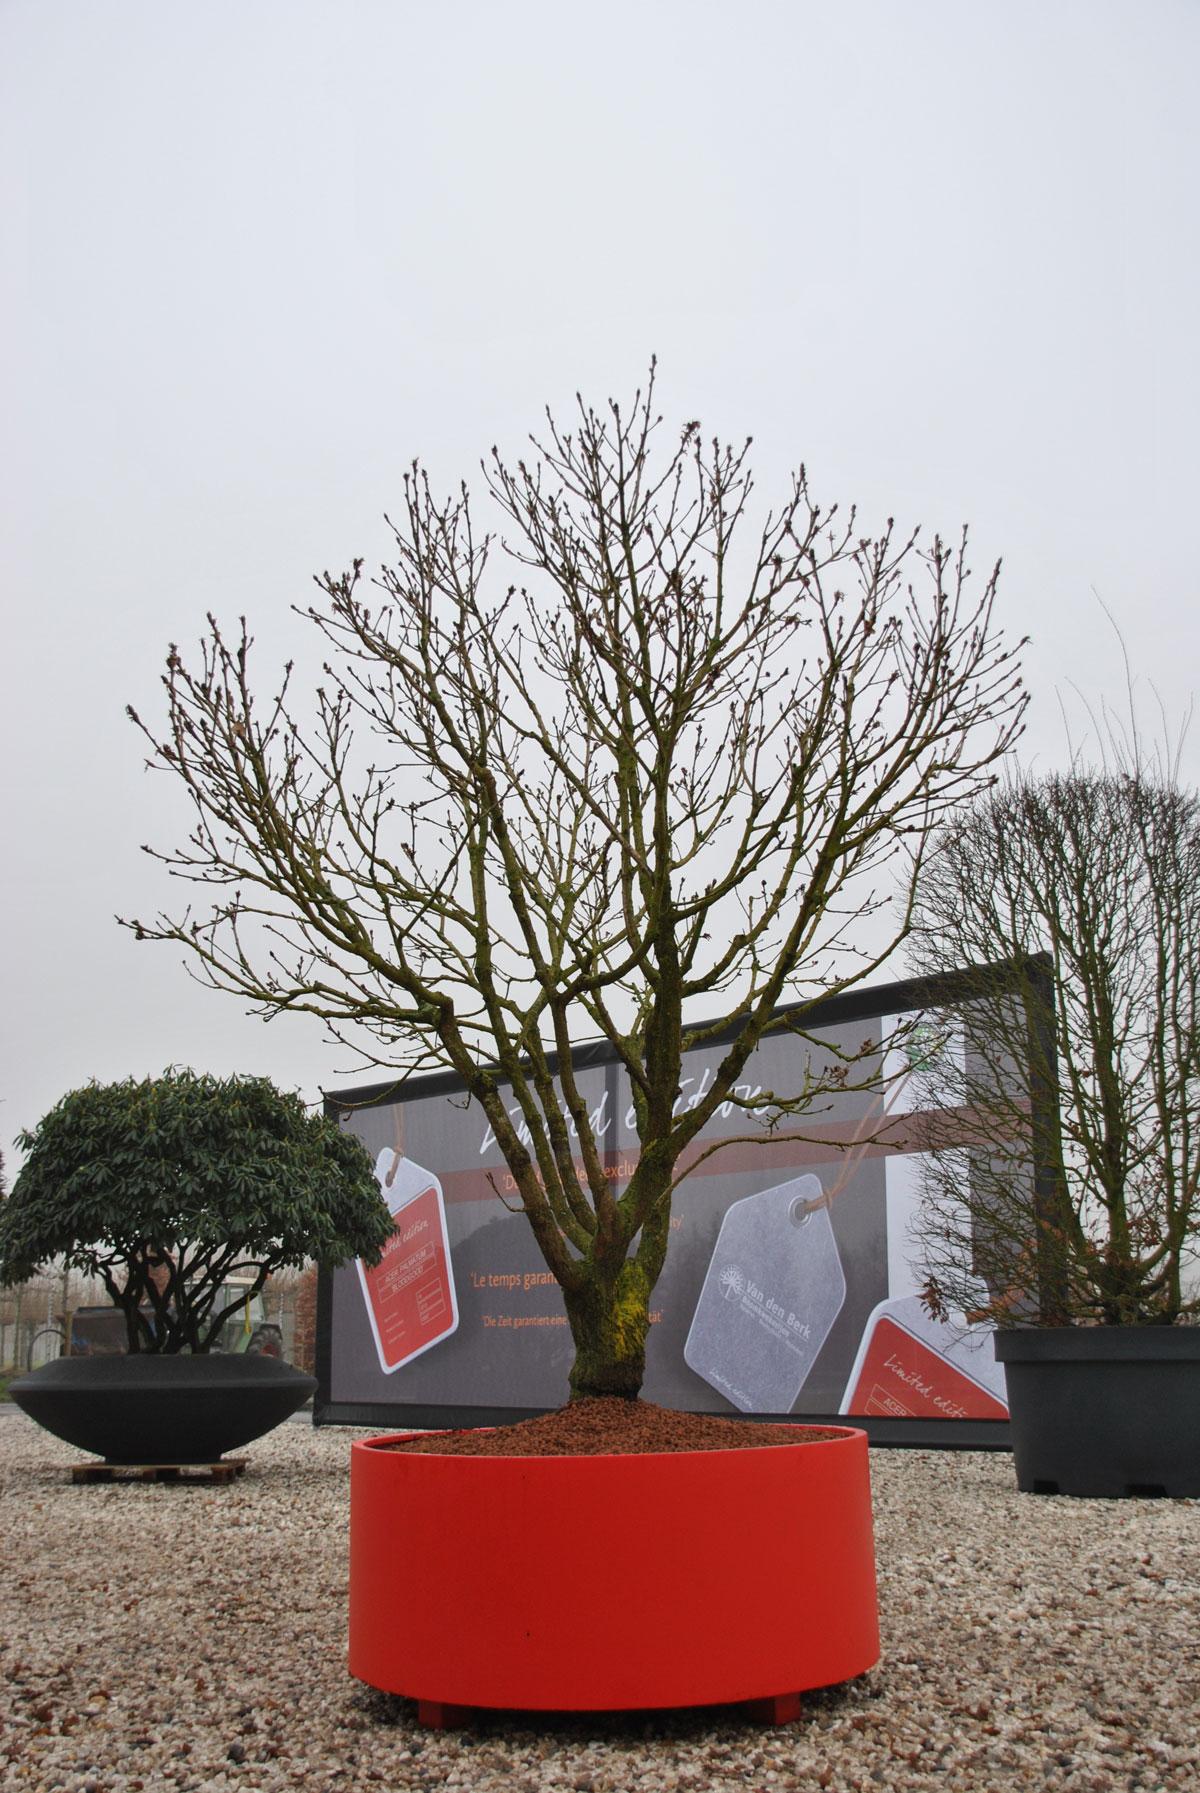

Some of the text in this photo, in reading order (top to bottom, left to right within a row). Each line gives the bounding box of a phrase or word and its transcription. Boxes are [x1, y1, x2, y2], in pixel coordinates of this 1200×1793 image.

[488, 1273, 521, 1291] temps
[746, 1280, 811, 1339] Van den Berk
[883, 1353, 933, 1399] Limited
